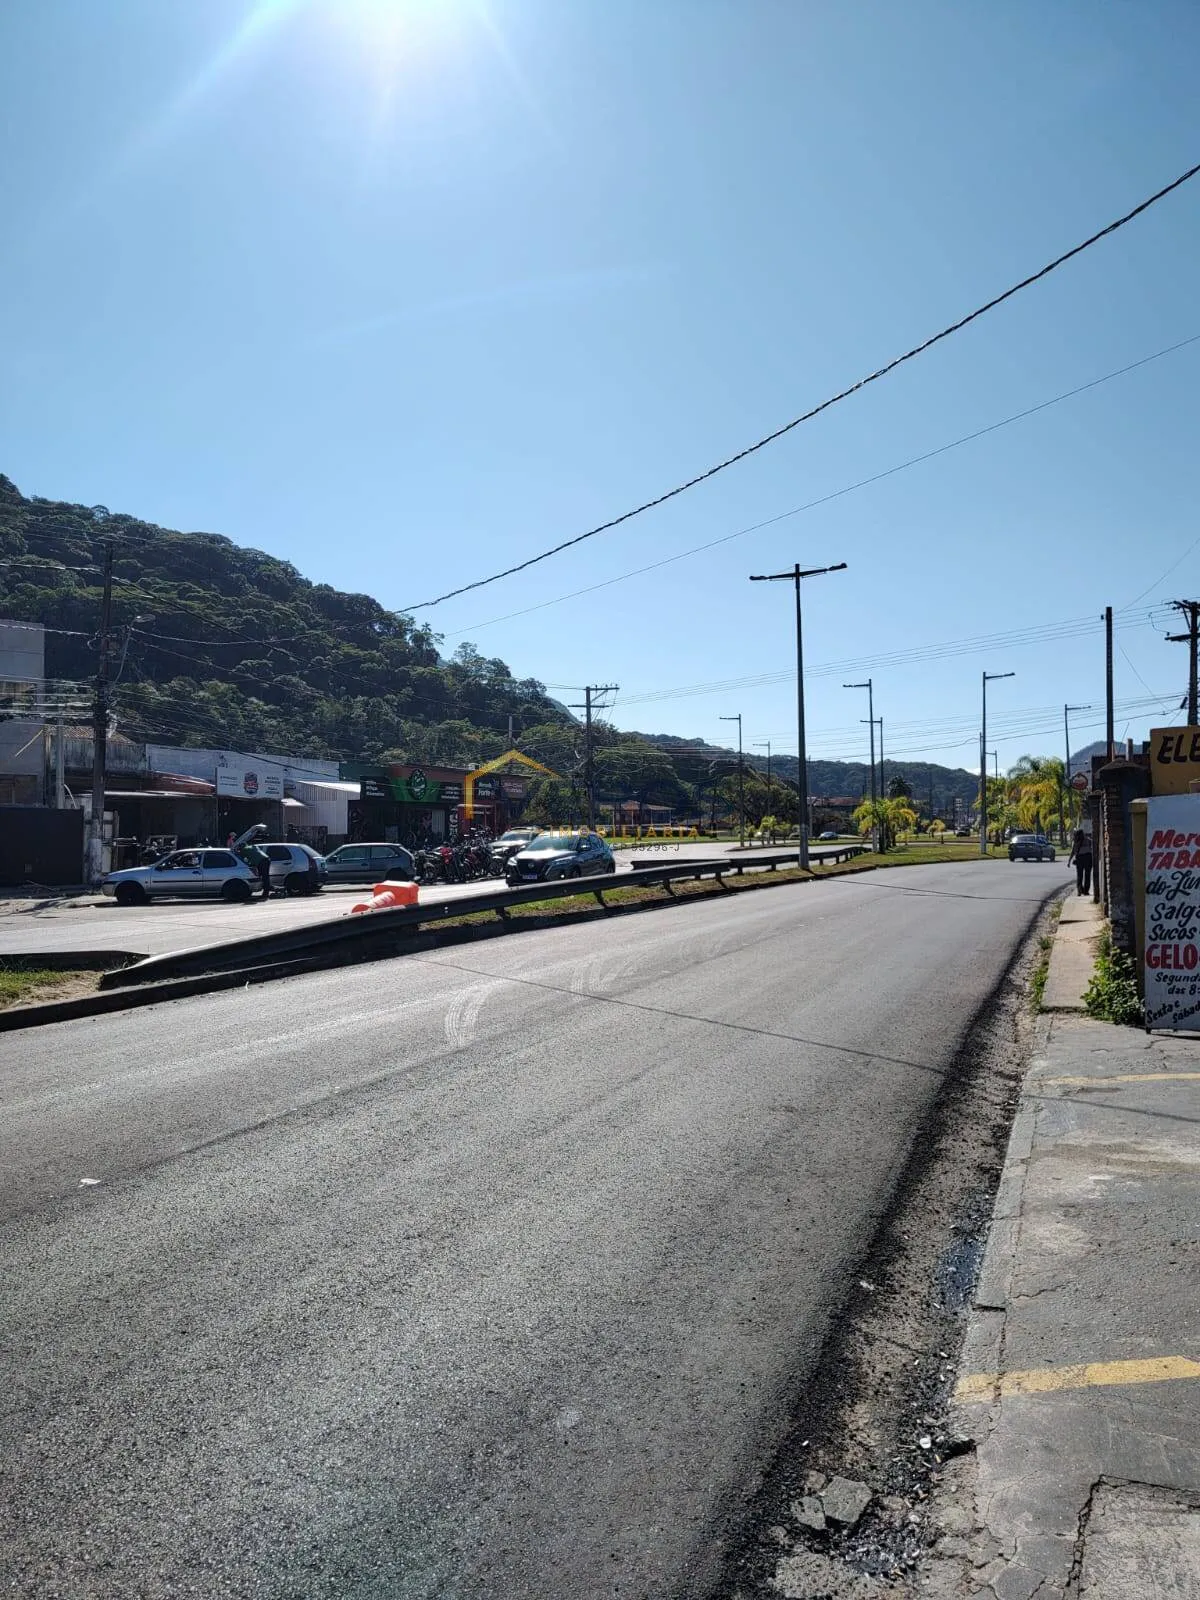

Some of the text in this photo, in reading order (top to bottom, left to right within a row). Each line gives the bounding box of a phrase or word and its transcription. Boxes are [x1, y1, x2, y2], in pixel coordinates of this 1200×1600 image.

[1149, 924, 1197, 941] Sucos
[1146, 944, 1198, 970] GELO
[1155, 971, 1200, 985] Segund
[1168, 985, 1186, 994] das
